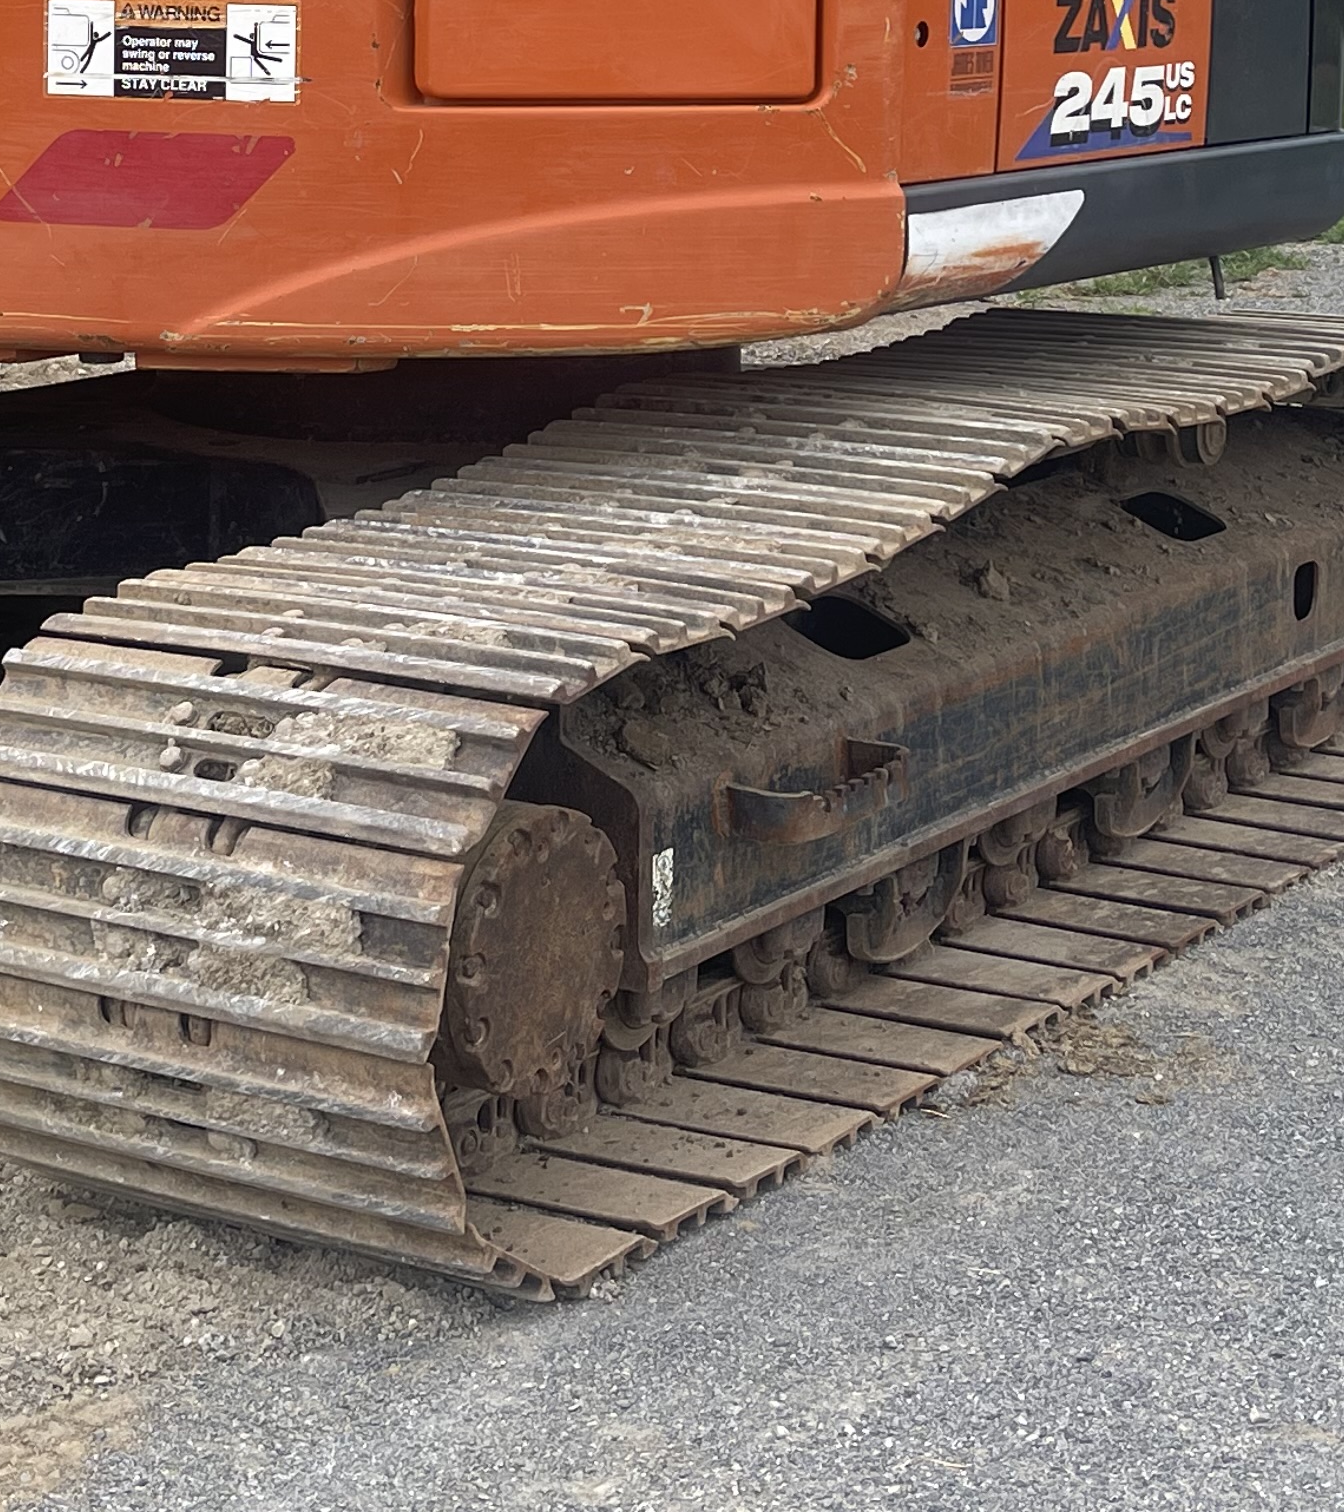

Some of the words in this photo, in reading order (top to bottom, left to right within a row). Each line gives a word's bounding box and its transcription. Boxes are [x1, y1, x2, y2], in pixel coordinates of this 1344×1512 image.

[137, 4, 221, 22] WARNING
[121, 34, 172, 49] Operator
[174, 37, 199, 50] may
[121, 49, 156, 62] swing
[157, 50, 170, 61] or
[172, 50, 215, 62] reverse
[121, 60, 170, 73] machine
[121, 77, 157, 90] STAY
[160, 78, 208, 92] CLEAR
[1050, 65, 1166, 142] 245
[1165, 61, 1197, 90] US
[1164, 93, 1193, 122] LC
